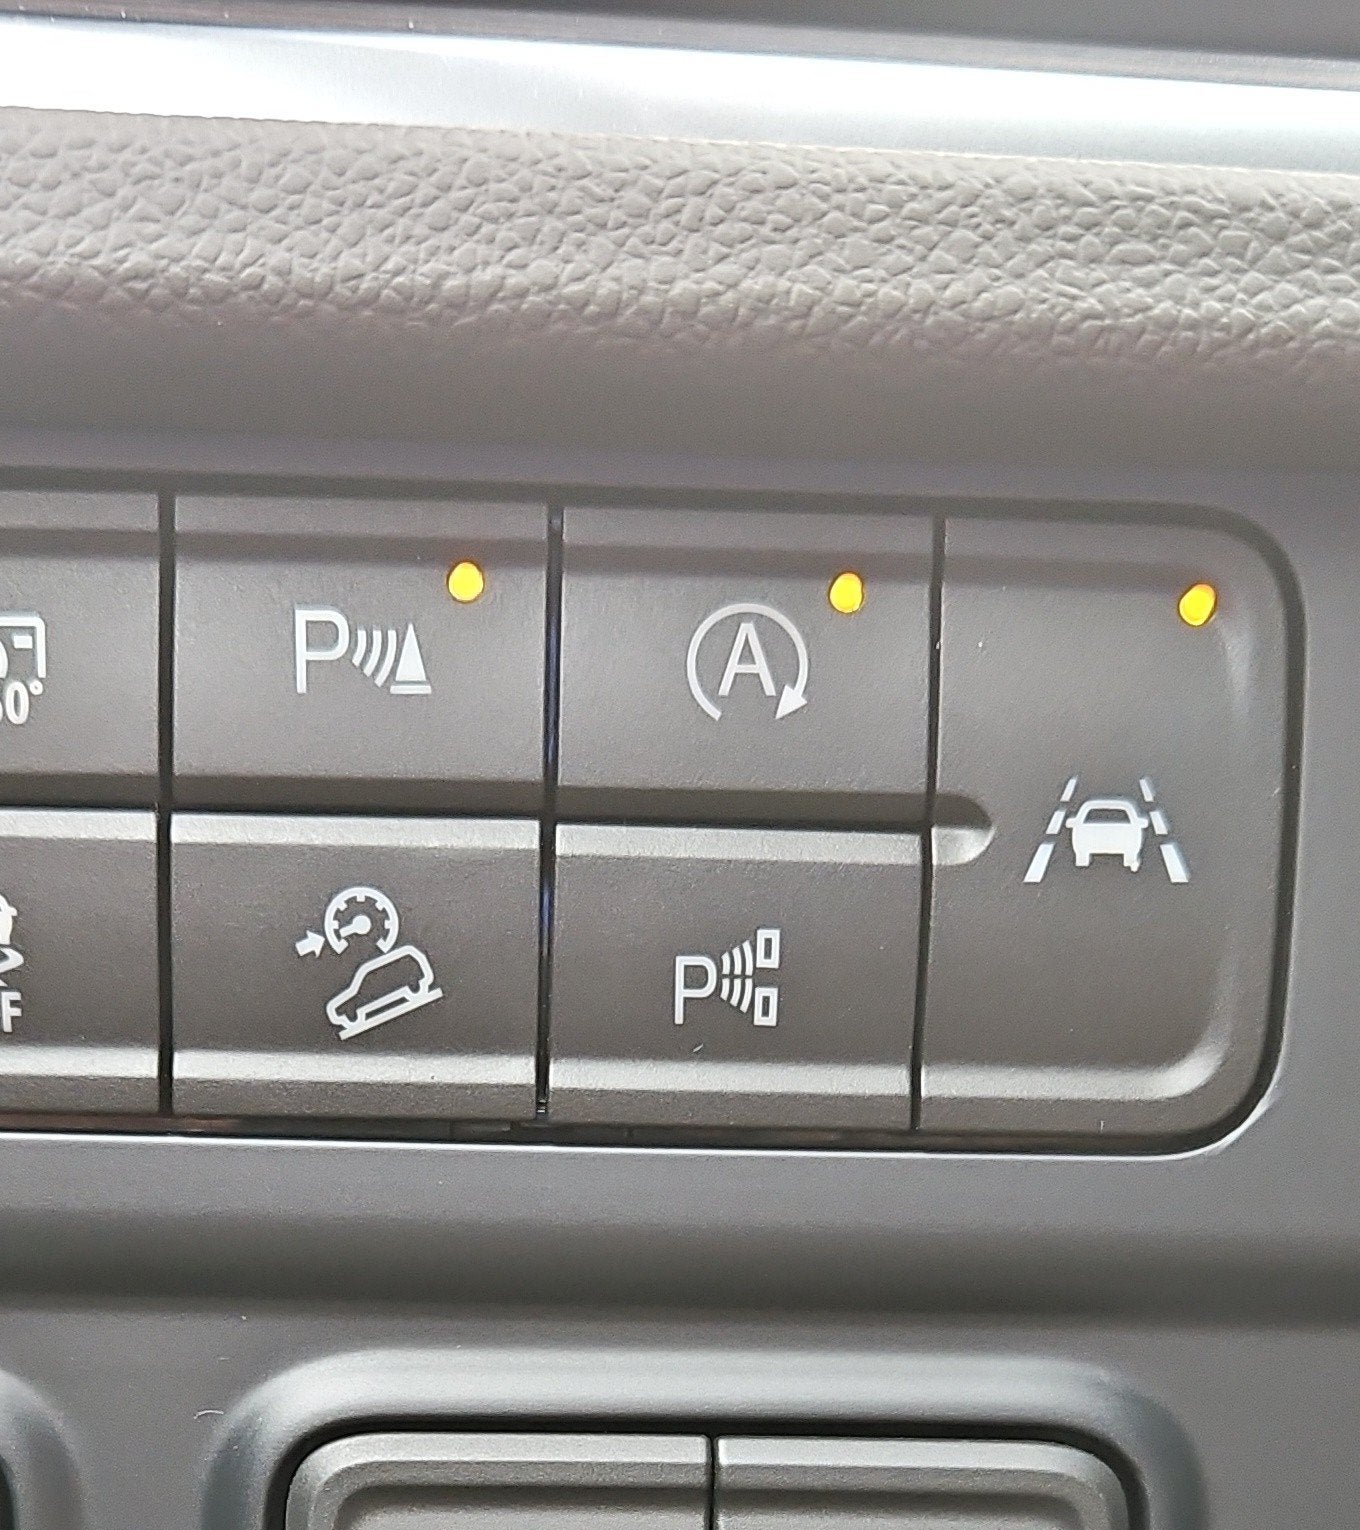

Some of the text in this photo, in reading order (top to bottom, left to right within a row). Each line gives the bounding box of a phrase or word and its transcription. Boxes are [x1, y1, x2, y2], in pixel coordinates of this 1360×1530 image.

[295, 605, 351, 694] P
[717, 619, 778, 698] A
[673, 954, 717, 1026] P
